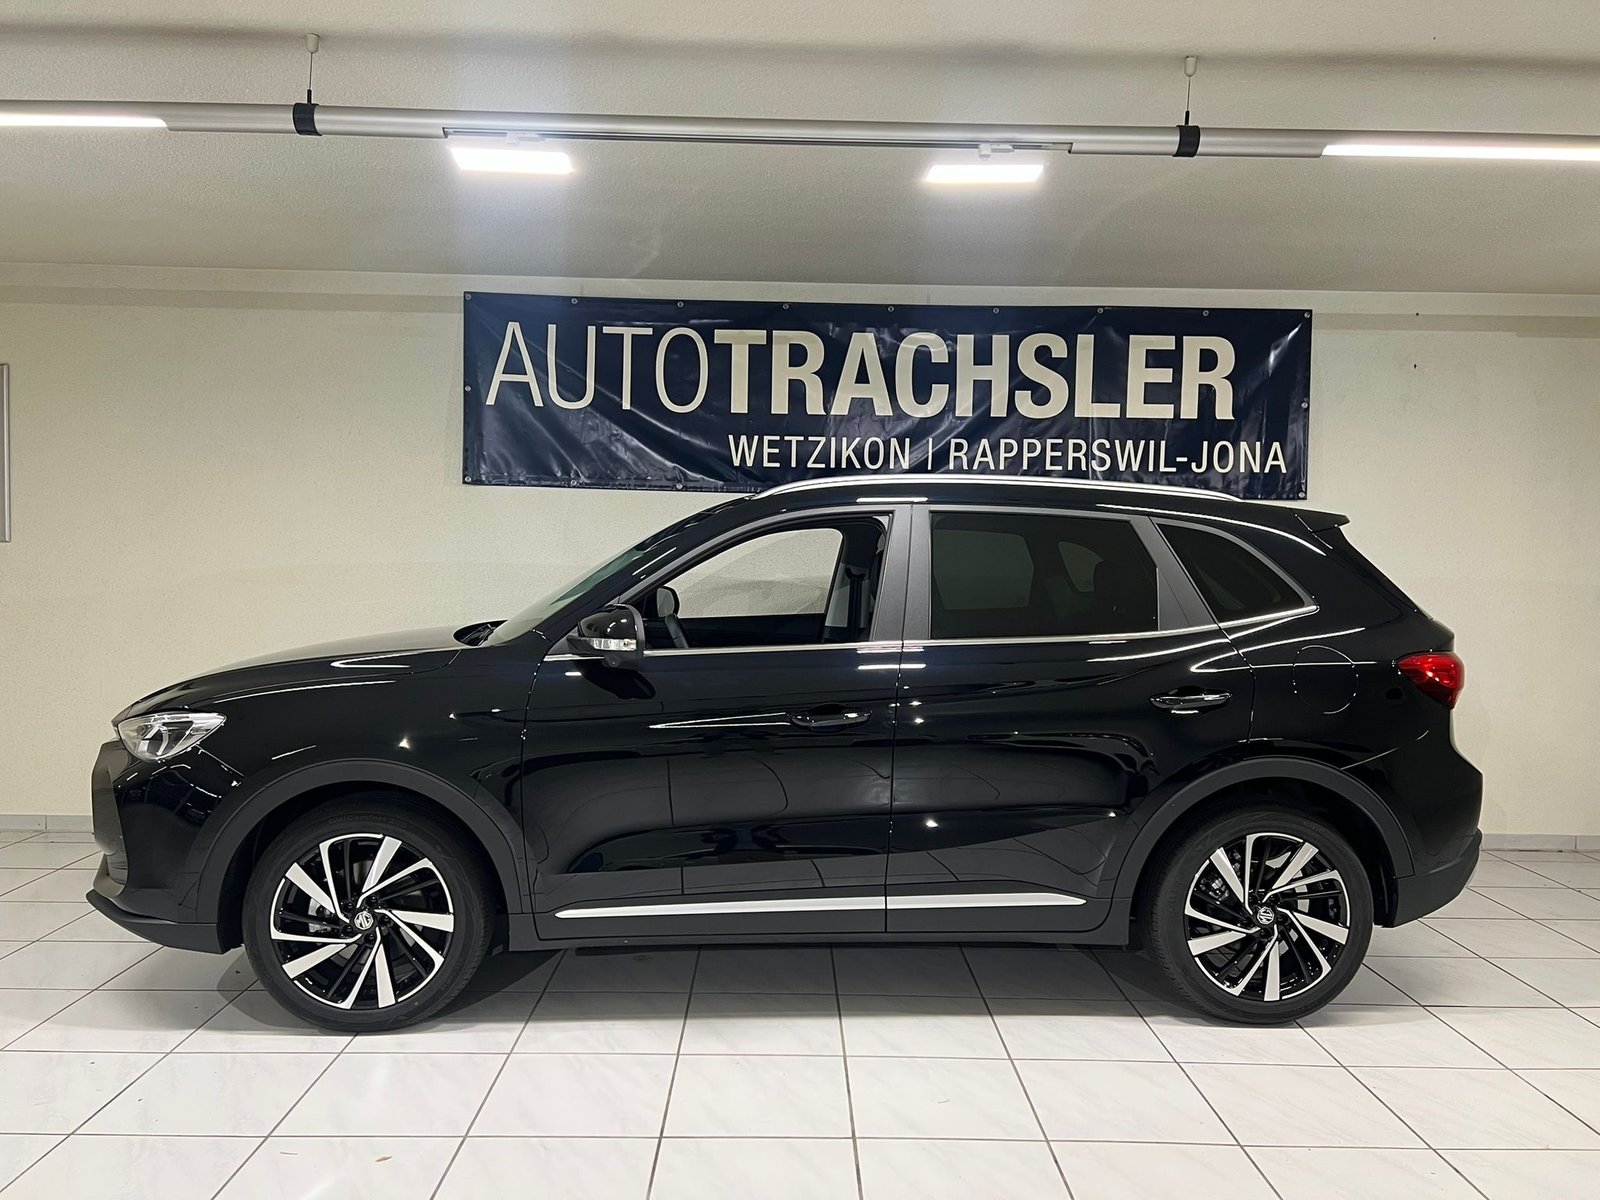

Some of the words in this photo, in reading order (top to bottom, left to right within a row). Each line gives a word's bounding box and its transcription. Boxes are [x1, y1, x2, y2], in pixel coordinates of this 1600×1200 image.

[485, 321, 1236, 420] AUTOTRACHSLER
[728, 434, 911, 470] WETZIKON
[949, 437, 1288, 474] RAPPERSWIL-JONA
[355, 912, 372, 929] MG
